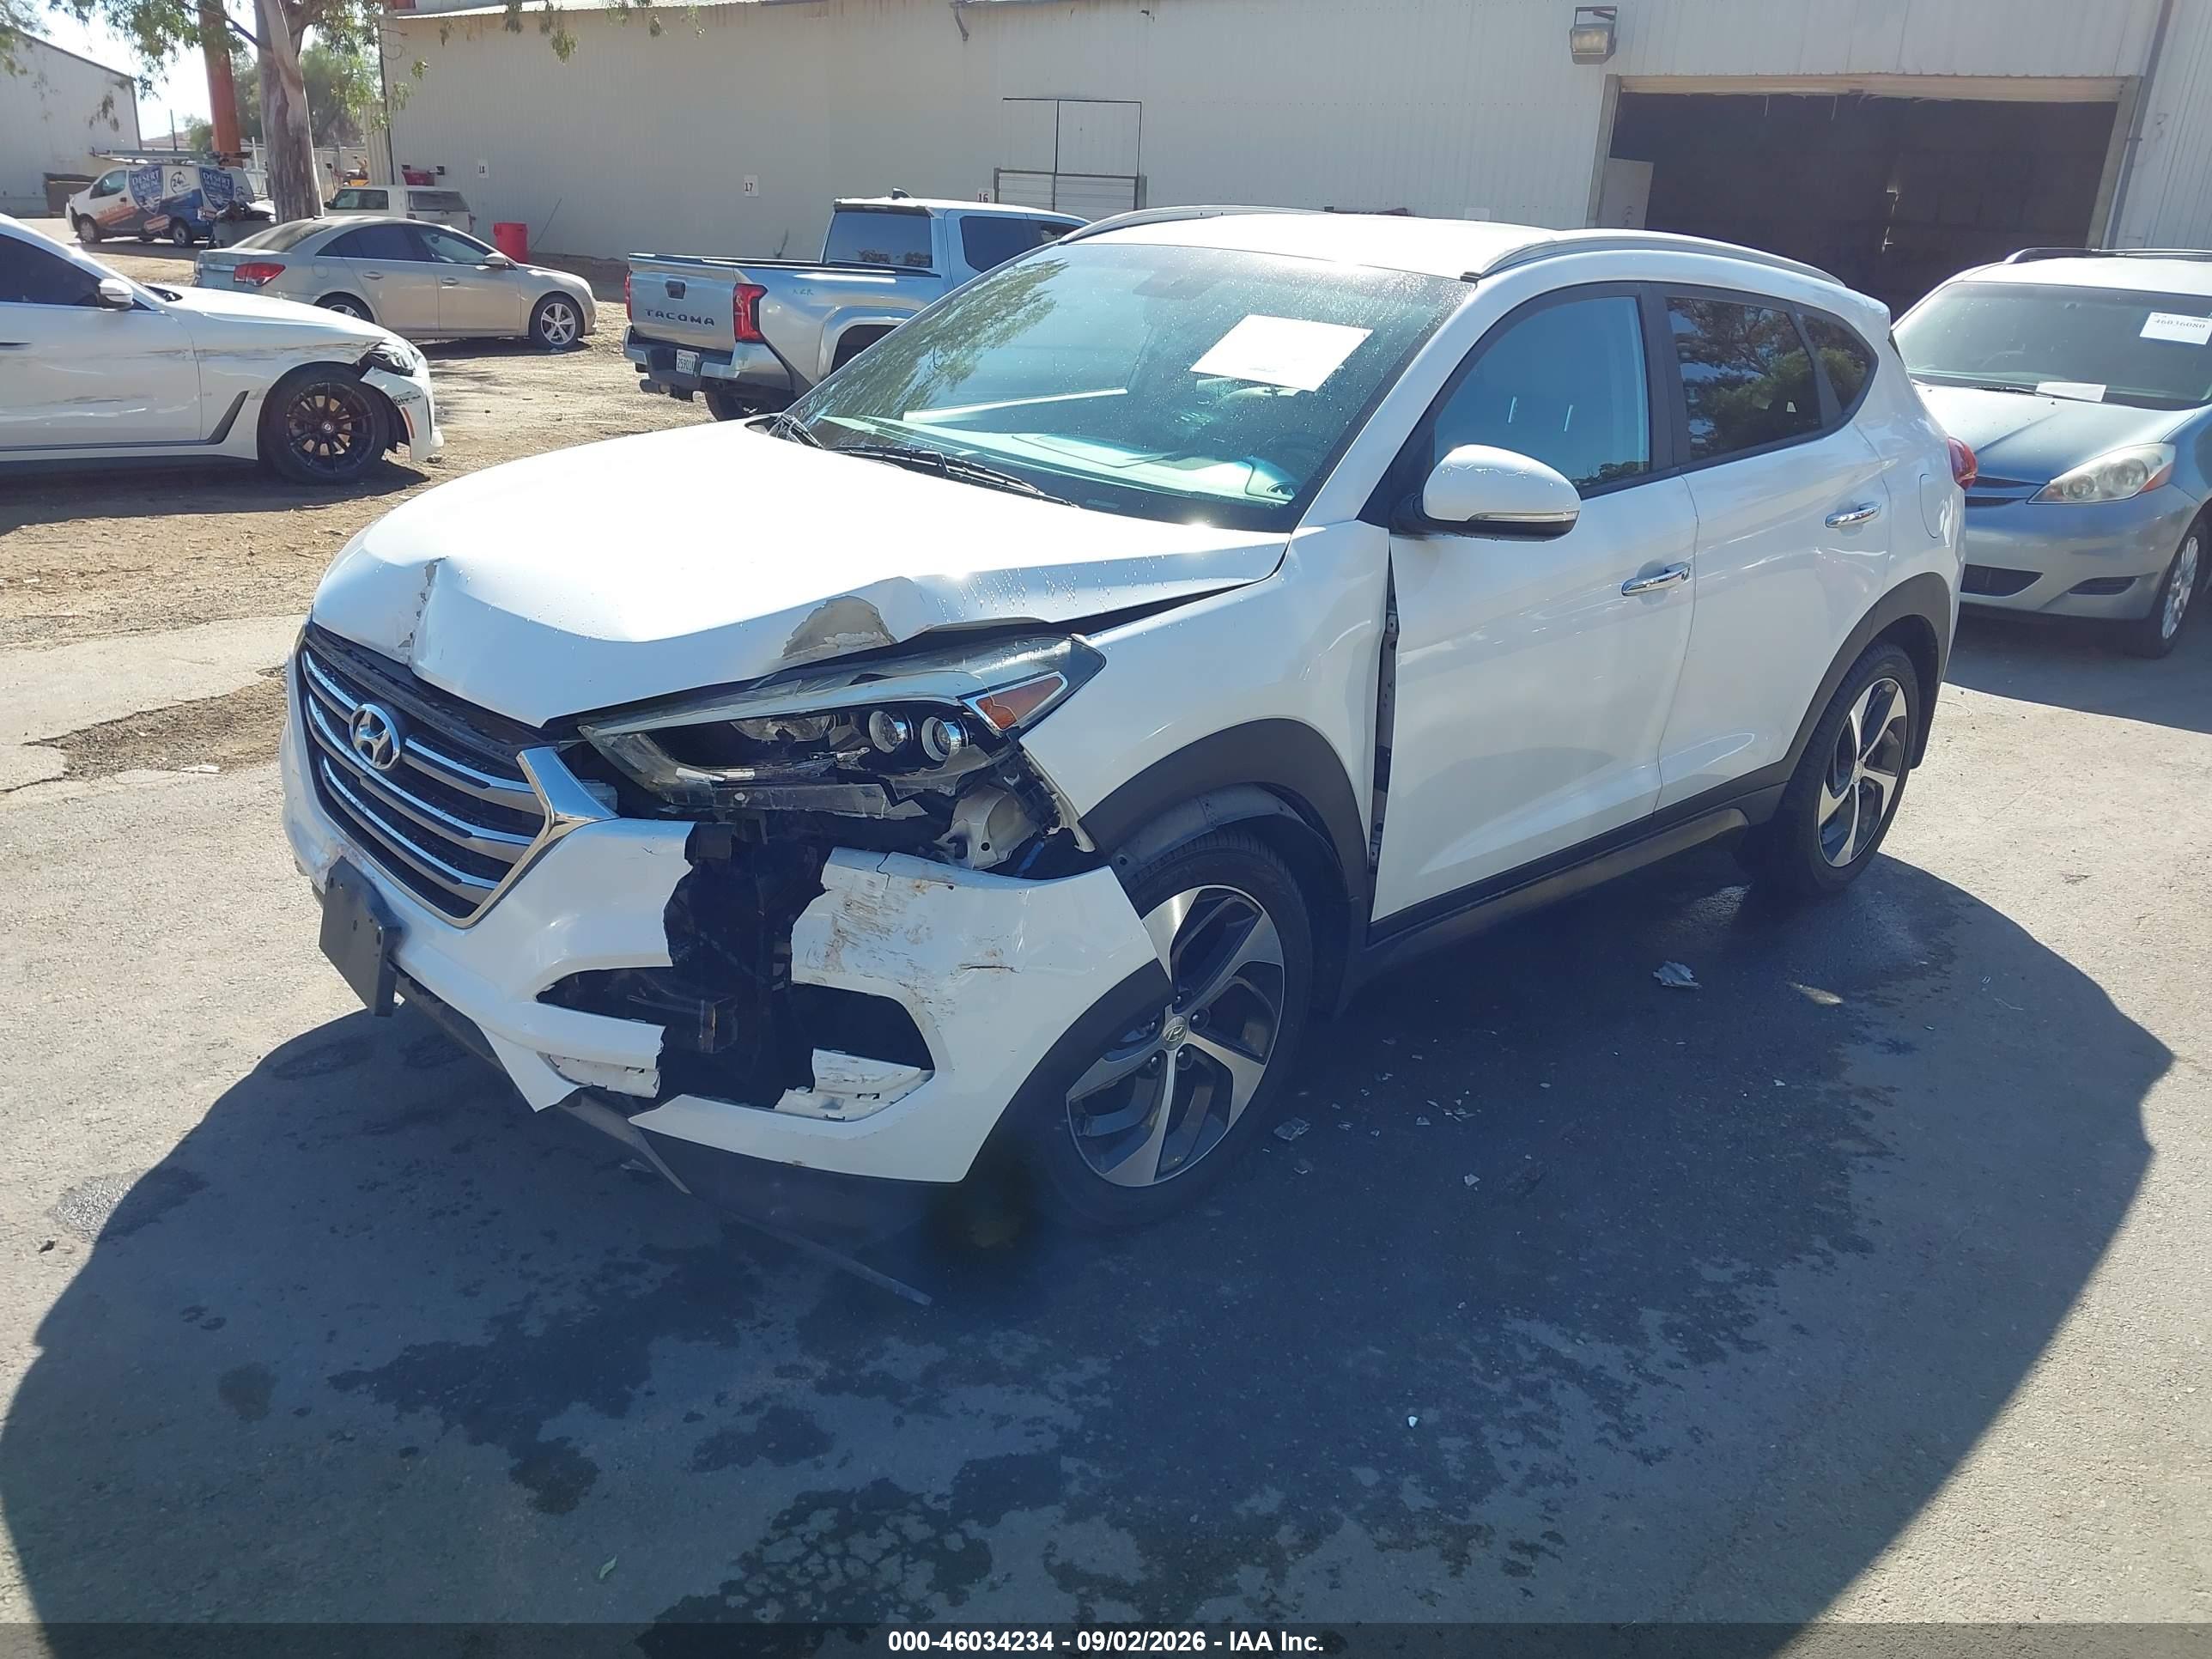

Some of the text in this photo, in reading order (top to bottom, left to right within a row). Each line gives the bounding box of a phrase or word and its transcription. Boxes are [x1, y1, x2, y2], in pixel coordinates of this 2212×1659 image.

[744, 182, 754, 192] 17
[978, 192, 988, 203] 16
[646, 309, 714, 326] TACOMA
